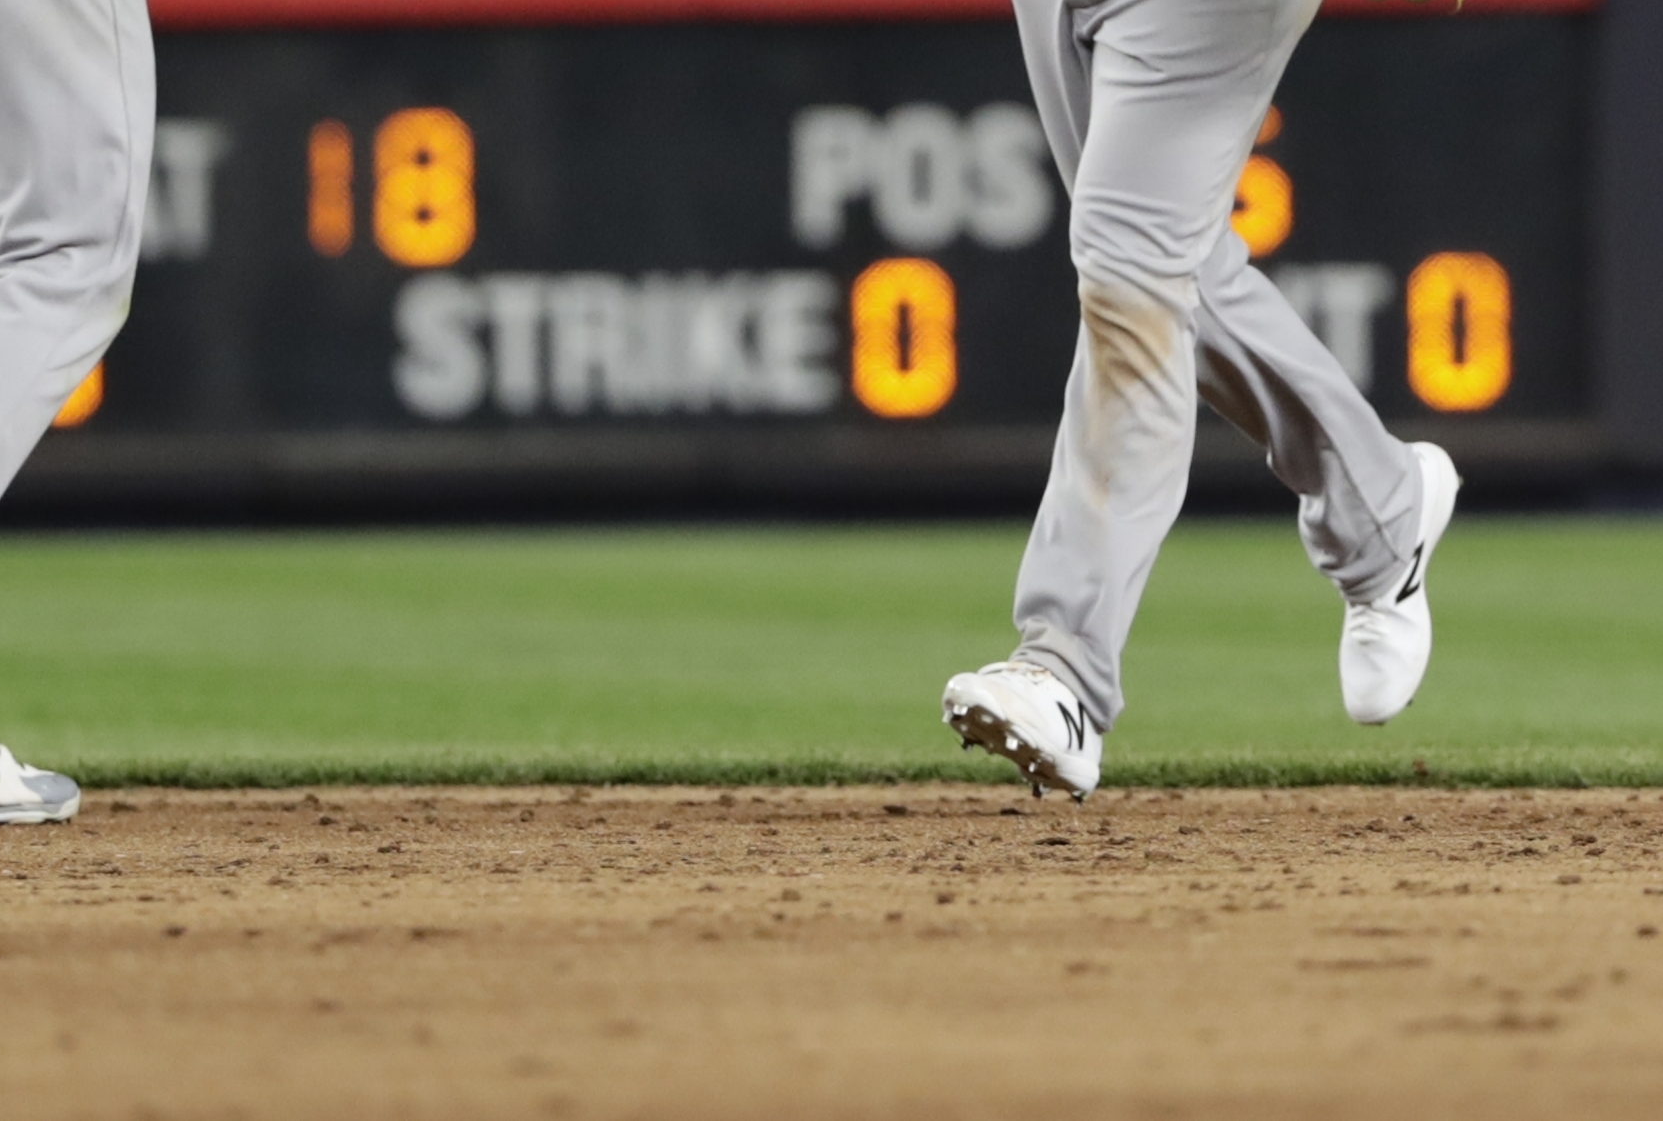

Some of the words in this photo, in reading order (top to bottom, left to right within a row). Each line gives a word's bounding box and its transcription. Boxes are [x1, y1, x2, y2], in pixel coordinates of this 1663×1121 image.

[788, 101, 1056, 250] POS
[392, 267, 840, 422] STRIKE
[850, 257, 957, 418] 0
[1405, 251, 1512, 412] 0
